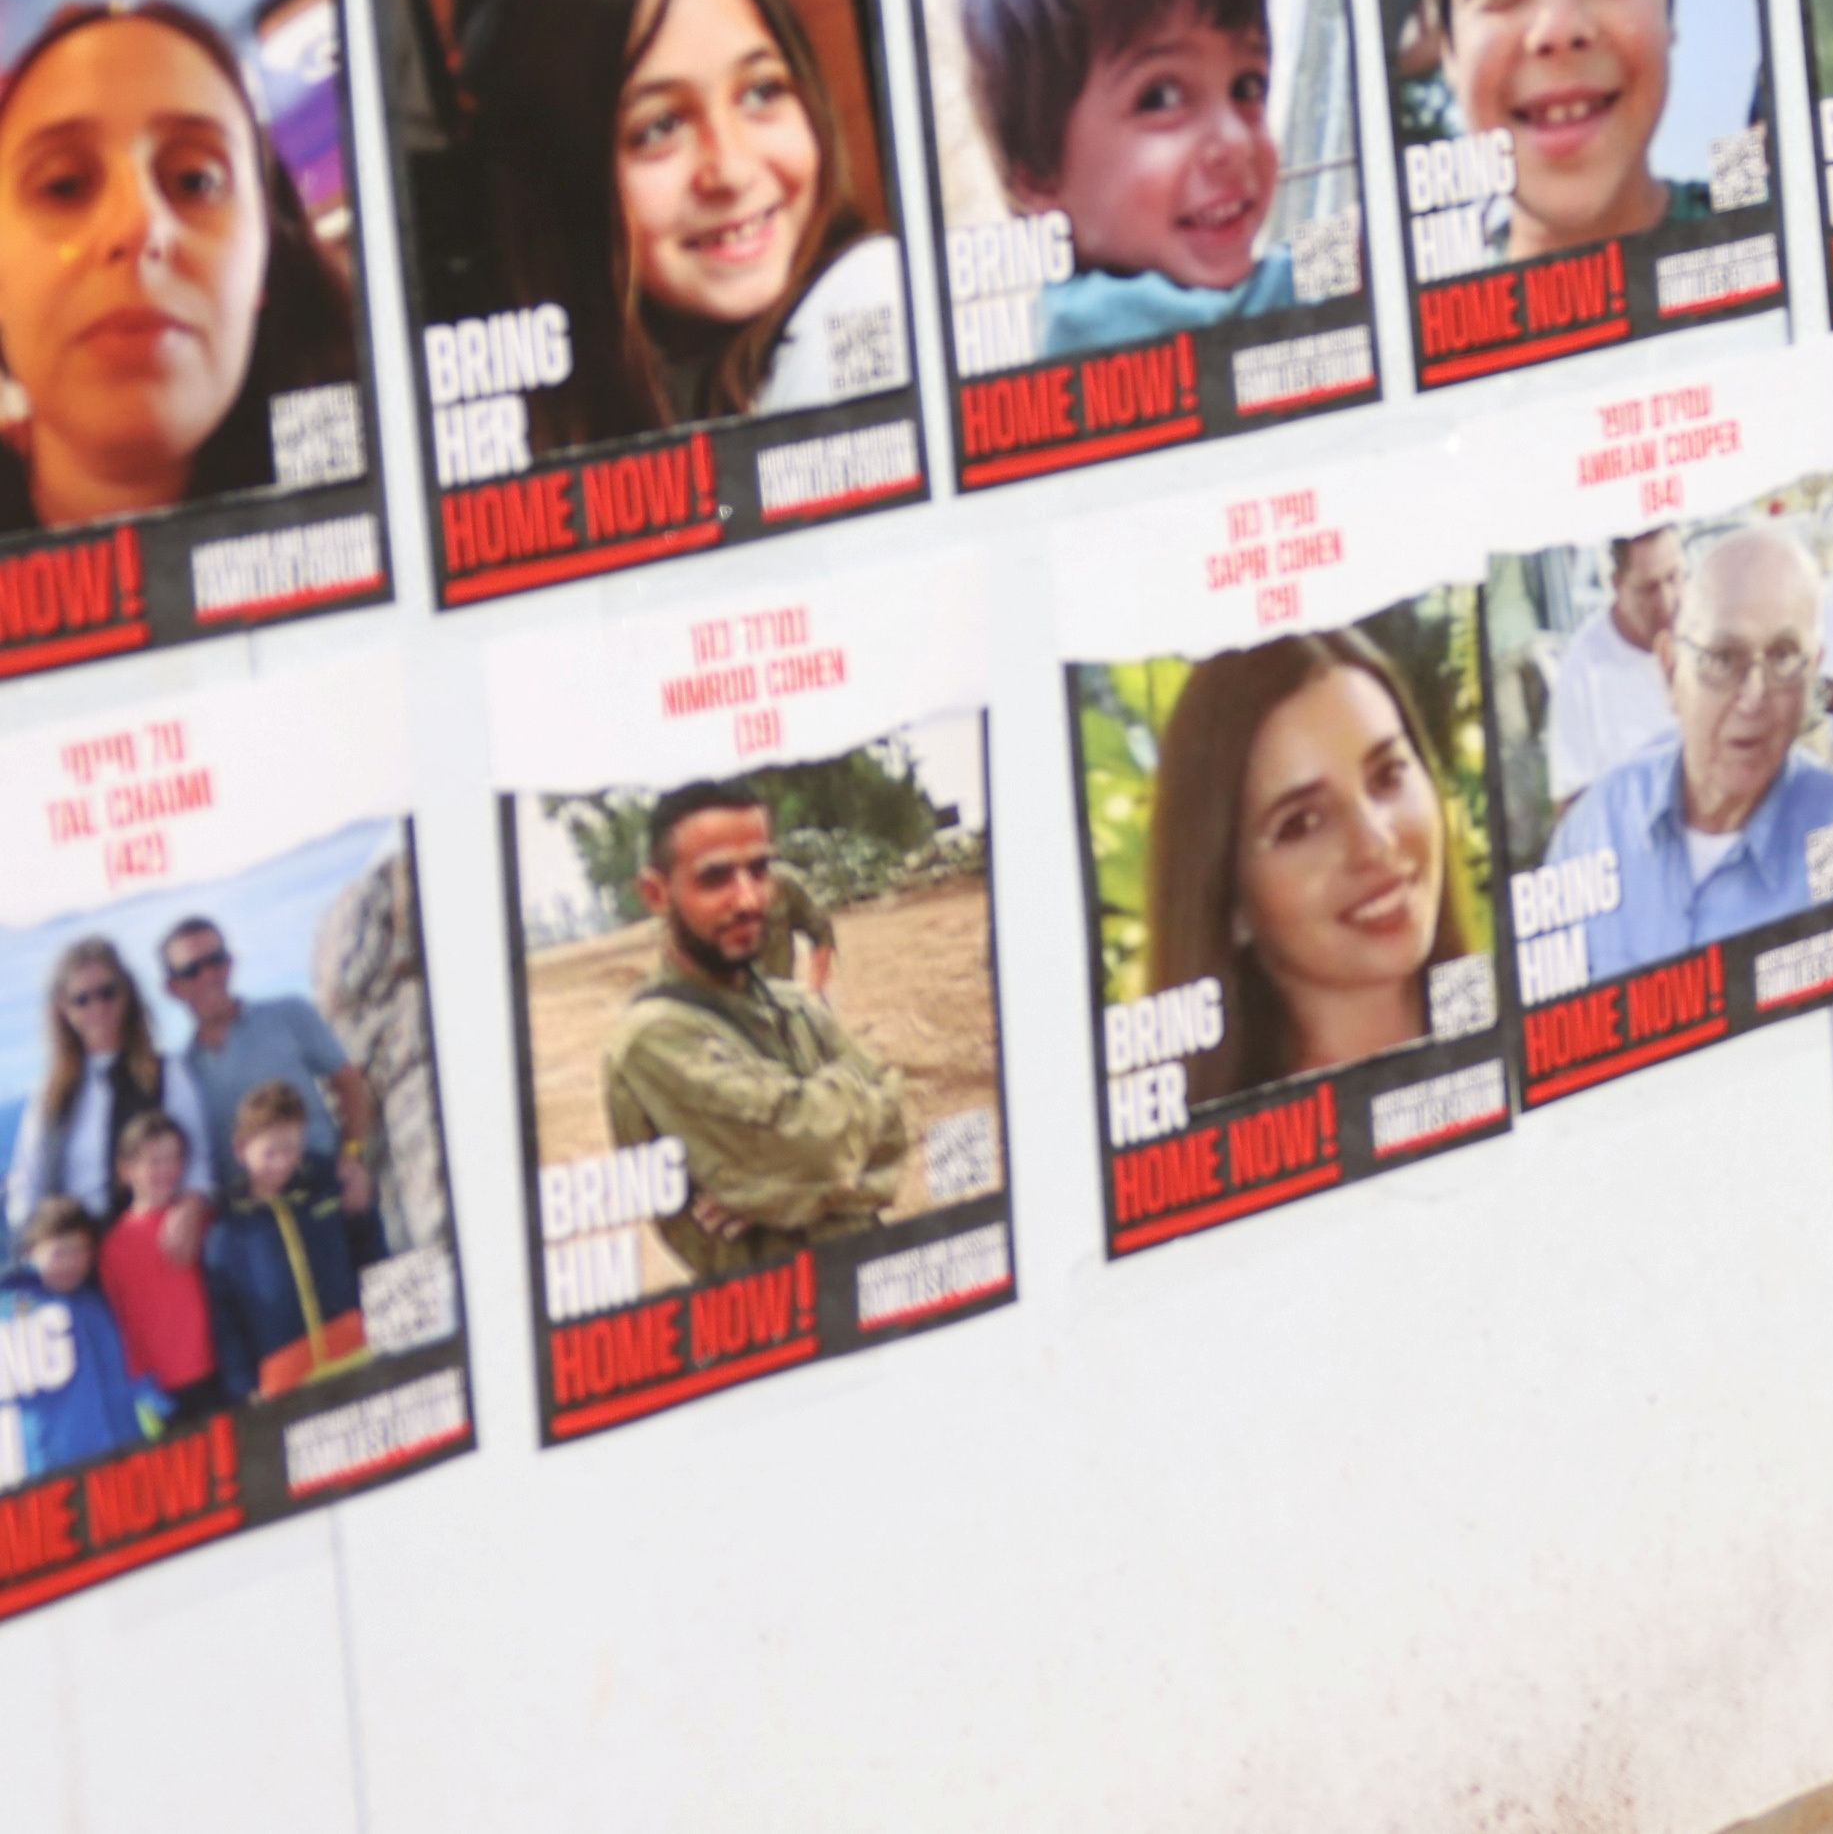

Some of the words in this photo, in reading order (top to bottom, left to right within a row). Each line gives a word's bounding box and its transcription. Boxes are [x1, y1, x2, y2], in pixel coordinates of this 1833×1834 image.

[947, 212, 1073, 297] BRING
[1420, 271, 1520, 356] HOME
[1526, 241, 1626, 328] NOW!
[423, 302, 572, 407] BRING
[954, 288, 1039, 376] HIM
[961, 369, 1075, 457] HOME
[1084, 333, 1197, 423] NOW!
[432, 395, 531, 487] HER
[1663, 422, 1742, 467] COOPER
[442, 469, 578, 572] HOME
[585, 432, 716, 541] NOW!
[1274, 530, 1345, 577] COHEN
[661, 671, 759, 719] NIMROD
[768, 650, 848, 695] COHEN
[47, 797, 100, 845] TAL
[108, 769, 214, 828] CHAIMI
[105, 832, 168, 888] (42)
[1103, 978, 1224, 1076] BRING
[1109, 1064, 1190, 1148] HER
[540, 1138, 687, 1241] BRING
[1114, 1129, 1224, 1223] HOME
[1231, 1083, 1339, 1189] NOW!
[547, 1237, 640, 1320] HIM
[552, 1301, 681, 1405] HOME
[692, 1249, 814, 1368] NOW!
